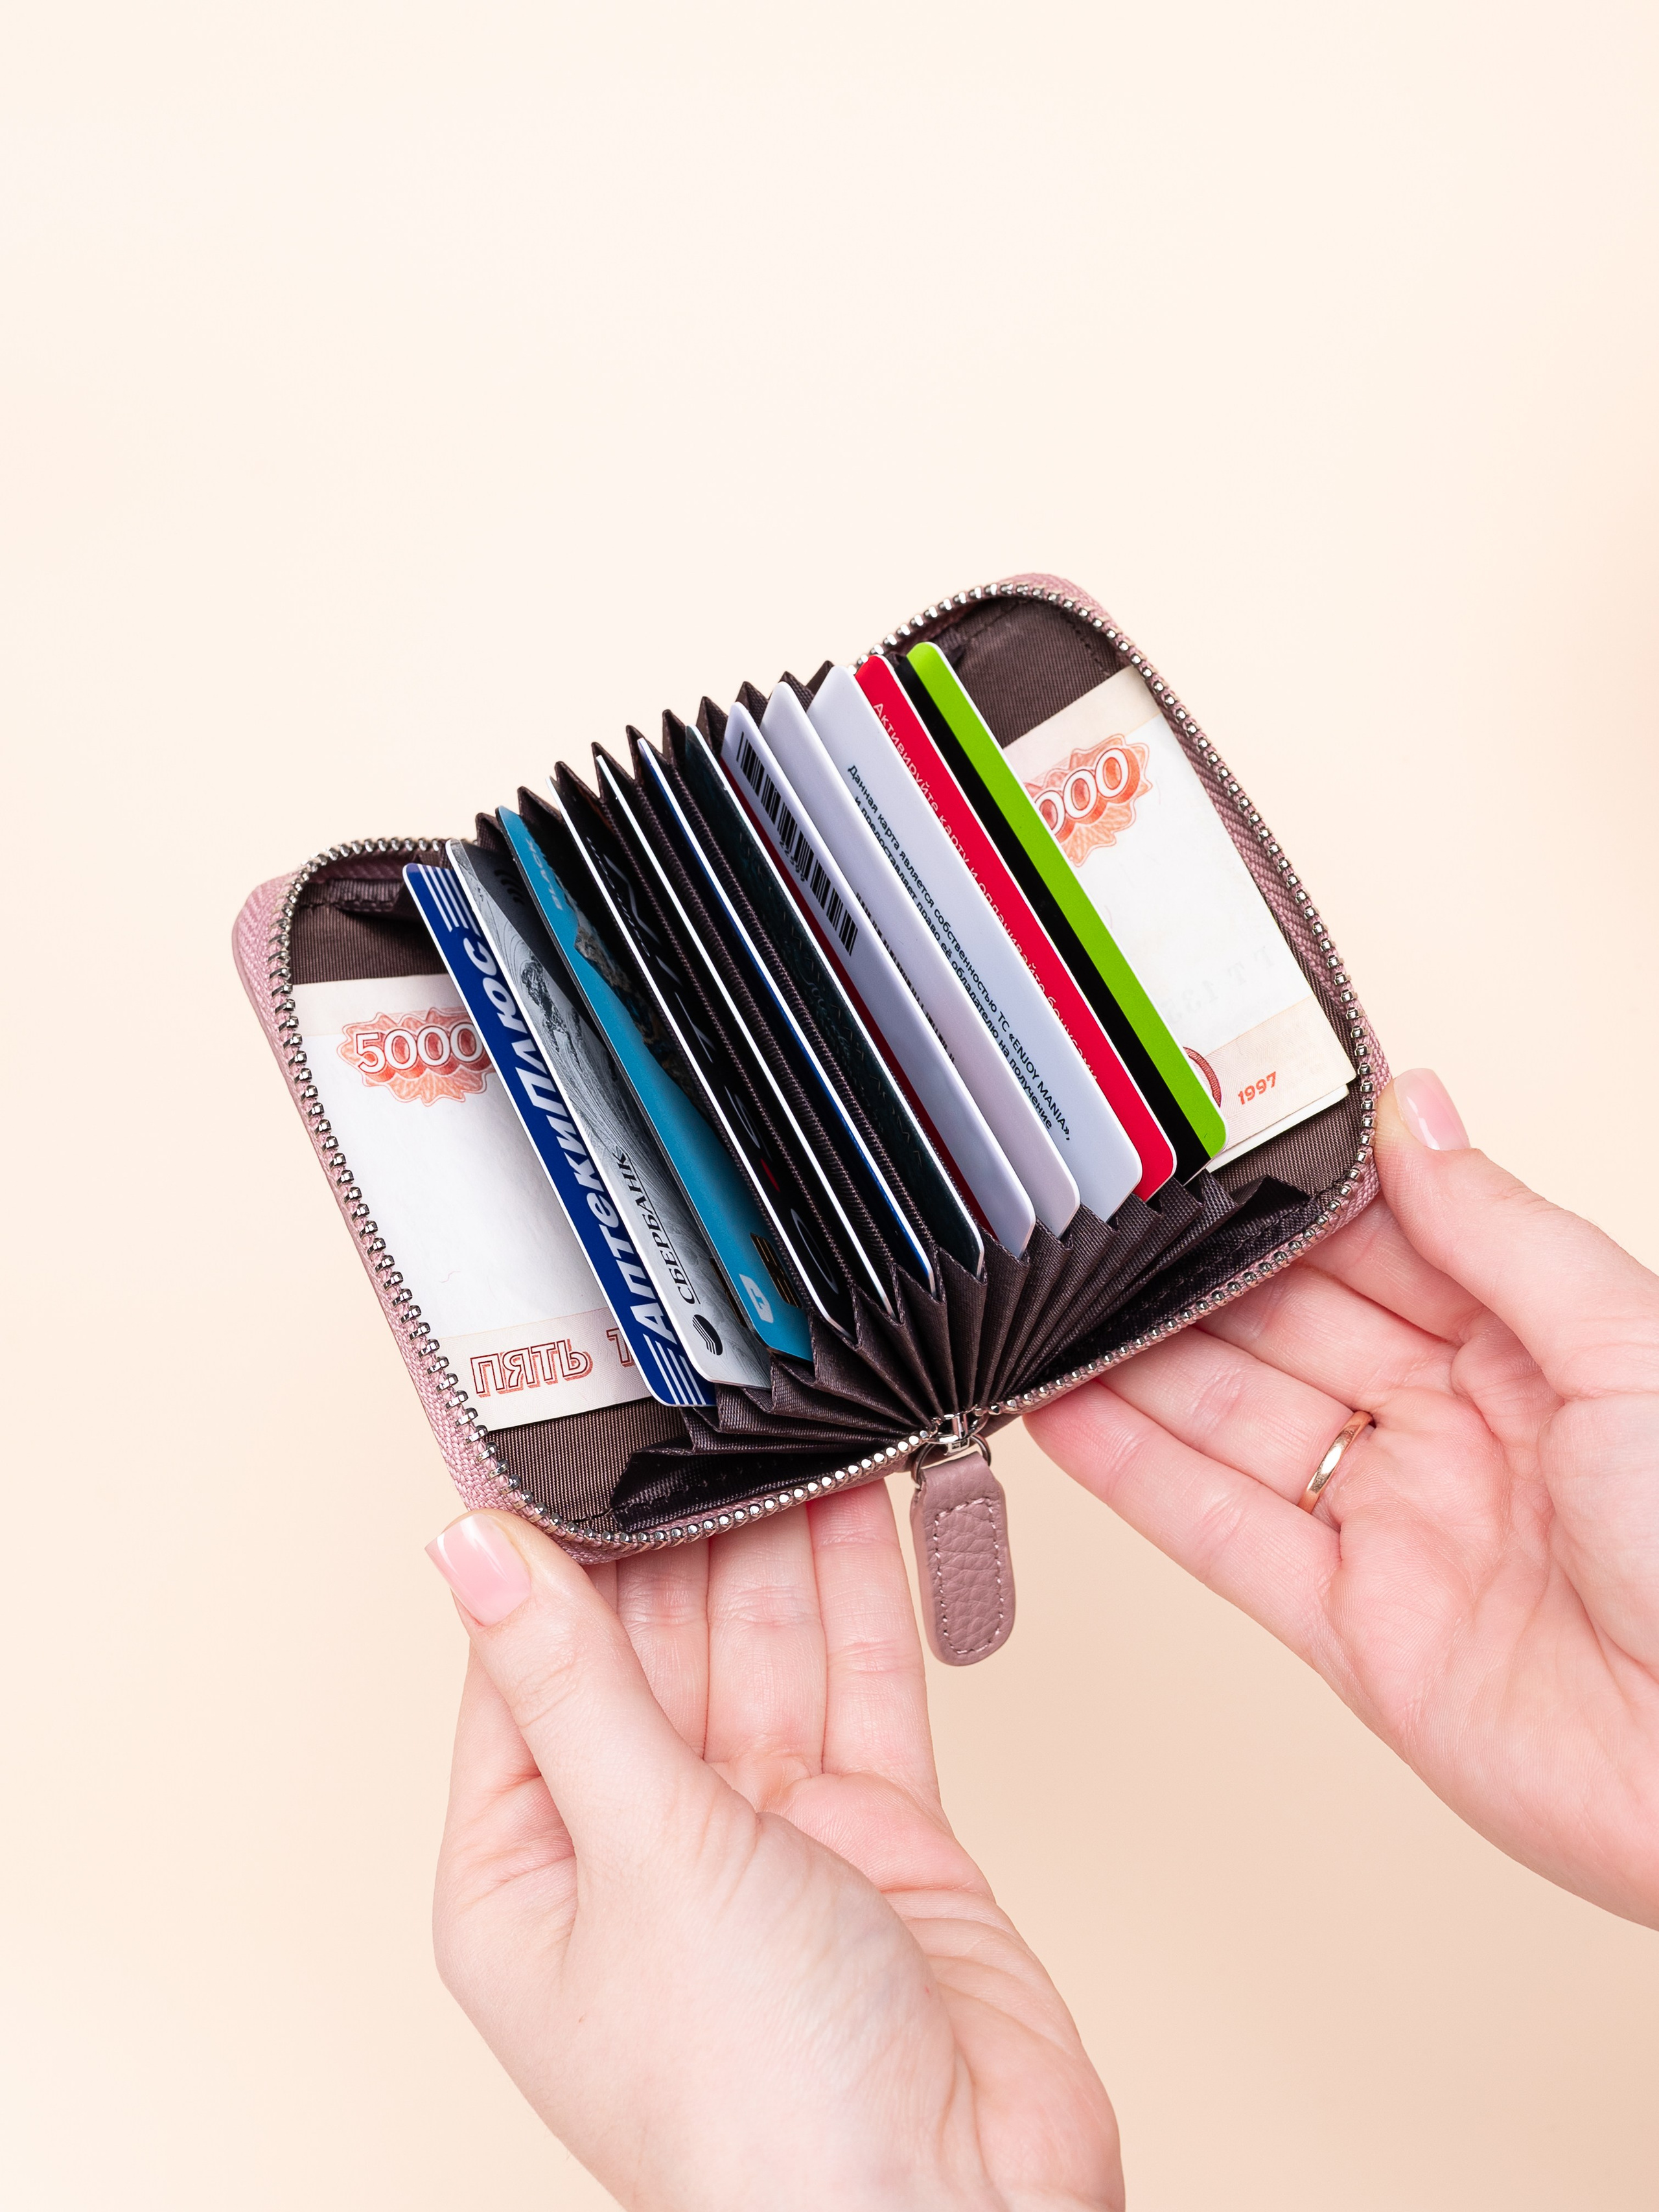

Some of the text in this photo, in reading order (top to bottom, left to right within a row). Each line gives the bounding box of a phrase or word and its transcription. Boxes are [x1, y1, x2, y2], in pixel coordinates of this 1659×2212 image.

[526, 838, 563, 910] BLACK
[586, 836, 650, 956] ostin.com
[847, 765, 1069, 1140] Данная карта является собственностью ТС «ENJOY MANIA»,
[855, 796, 861, 806] и
[916, 901, 940, 941] право
[940, 942, 952, 960] её
[951, 960, 998, 1038] обладателю
[998, 1039, 1009, 1057] на
[1009, 1058, 1051, 1129] получение
[356, 1021, 484, 1074] 5000
[1238, 1071, 1276, 1105] 1997
[463, 938, 678, 1345] АптекиПлюс
[612, 1151, 695, 1304] СБЕРБАНК
[470, 1339, 593, 1398] ПЯТЬ
